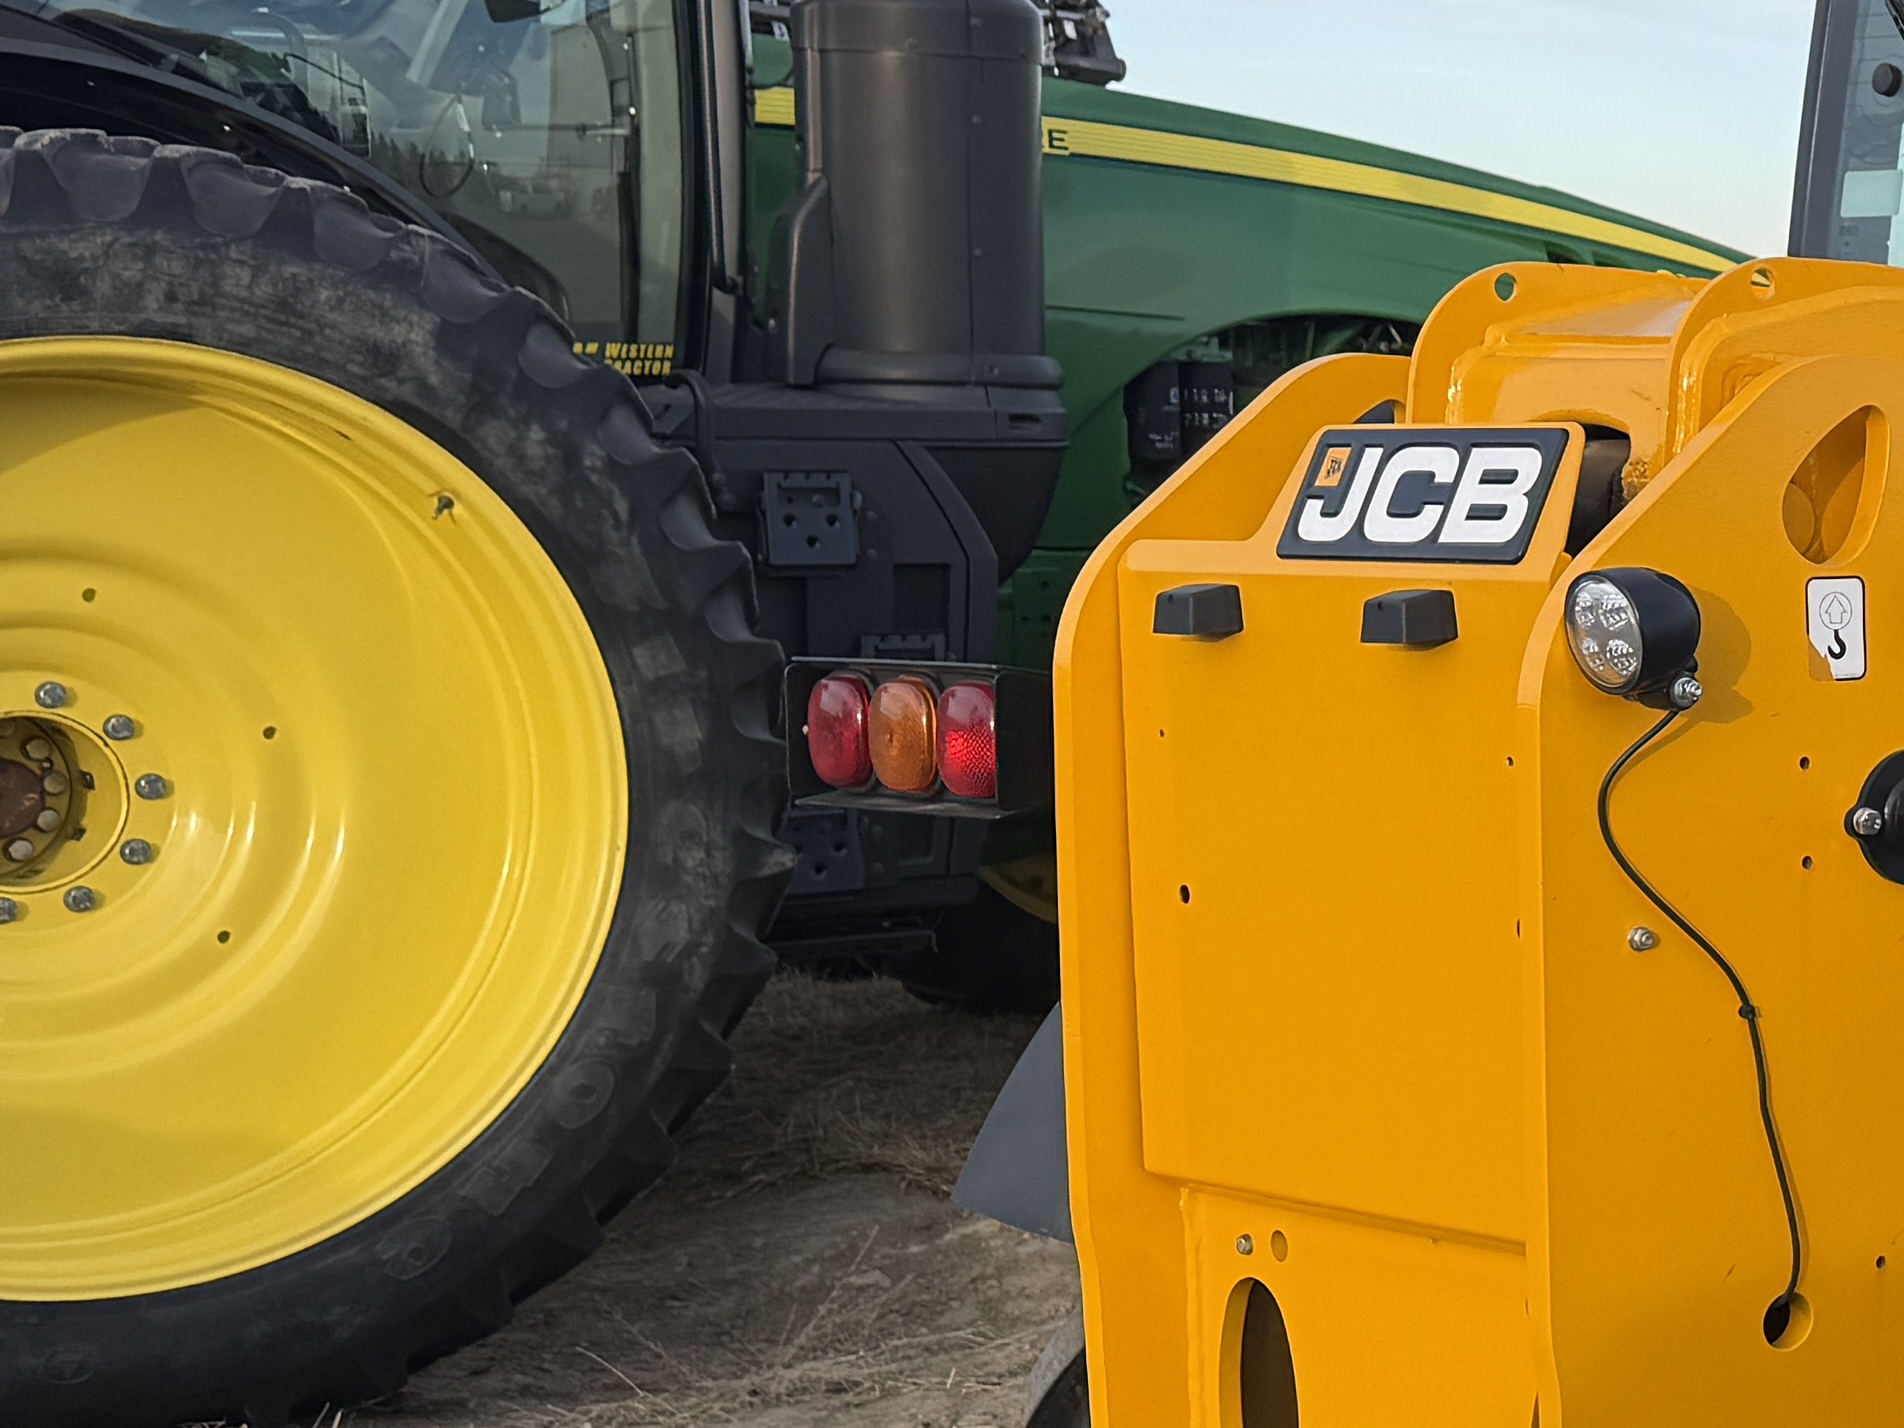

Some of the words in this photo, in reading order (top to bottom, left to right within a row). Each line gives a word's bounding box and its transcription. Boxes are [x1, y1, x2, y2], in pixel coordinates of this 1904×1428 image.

[605, 342, 674, 359] WESTERN
[604, 359, 672, 376] RACTOR
[1298, 446, 1543, 544] JCB
